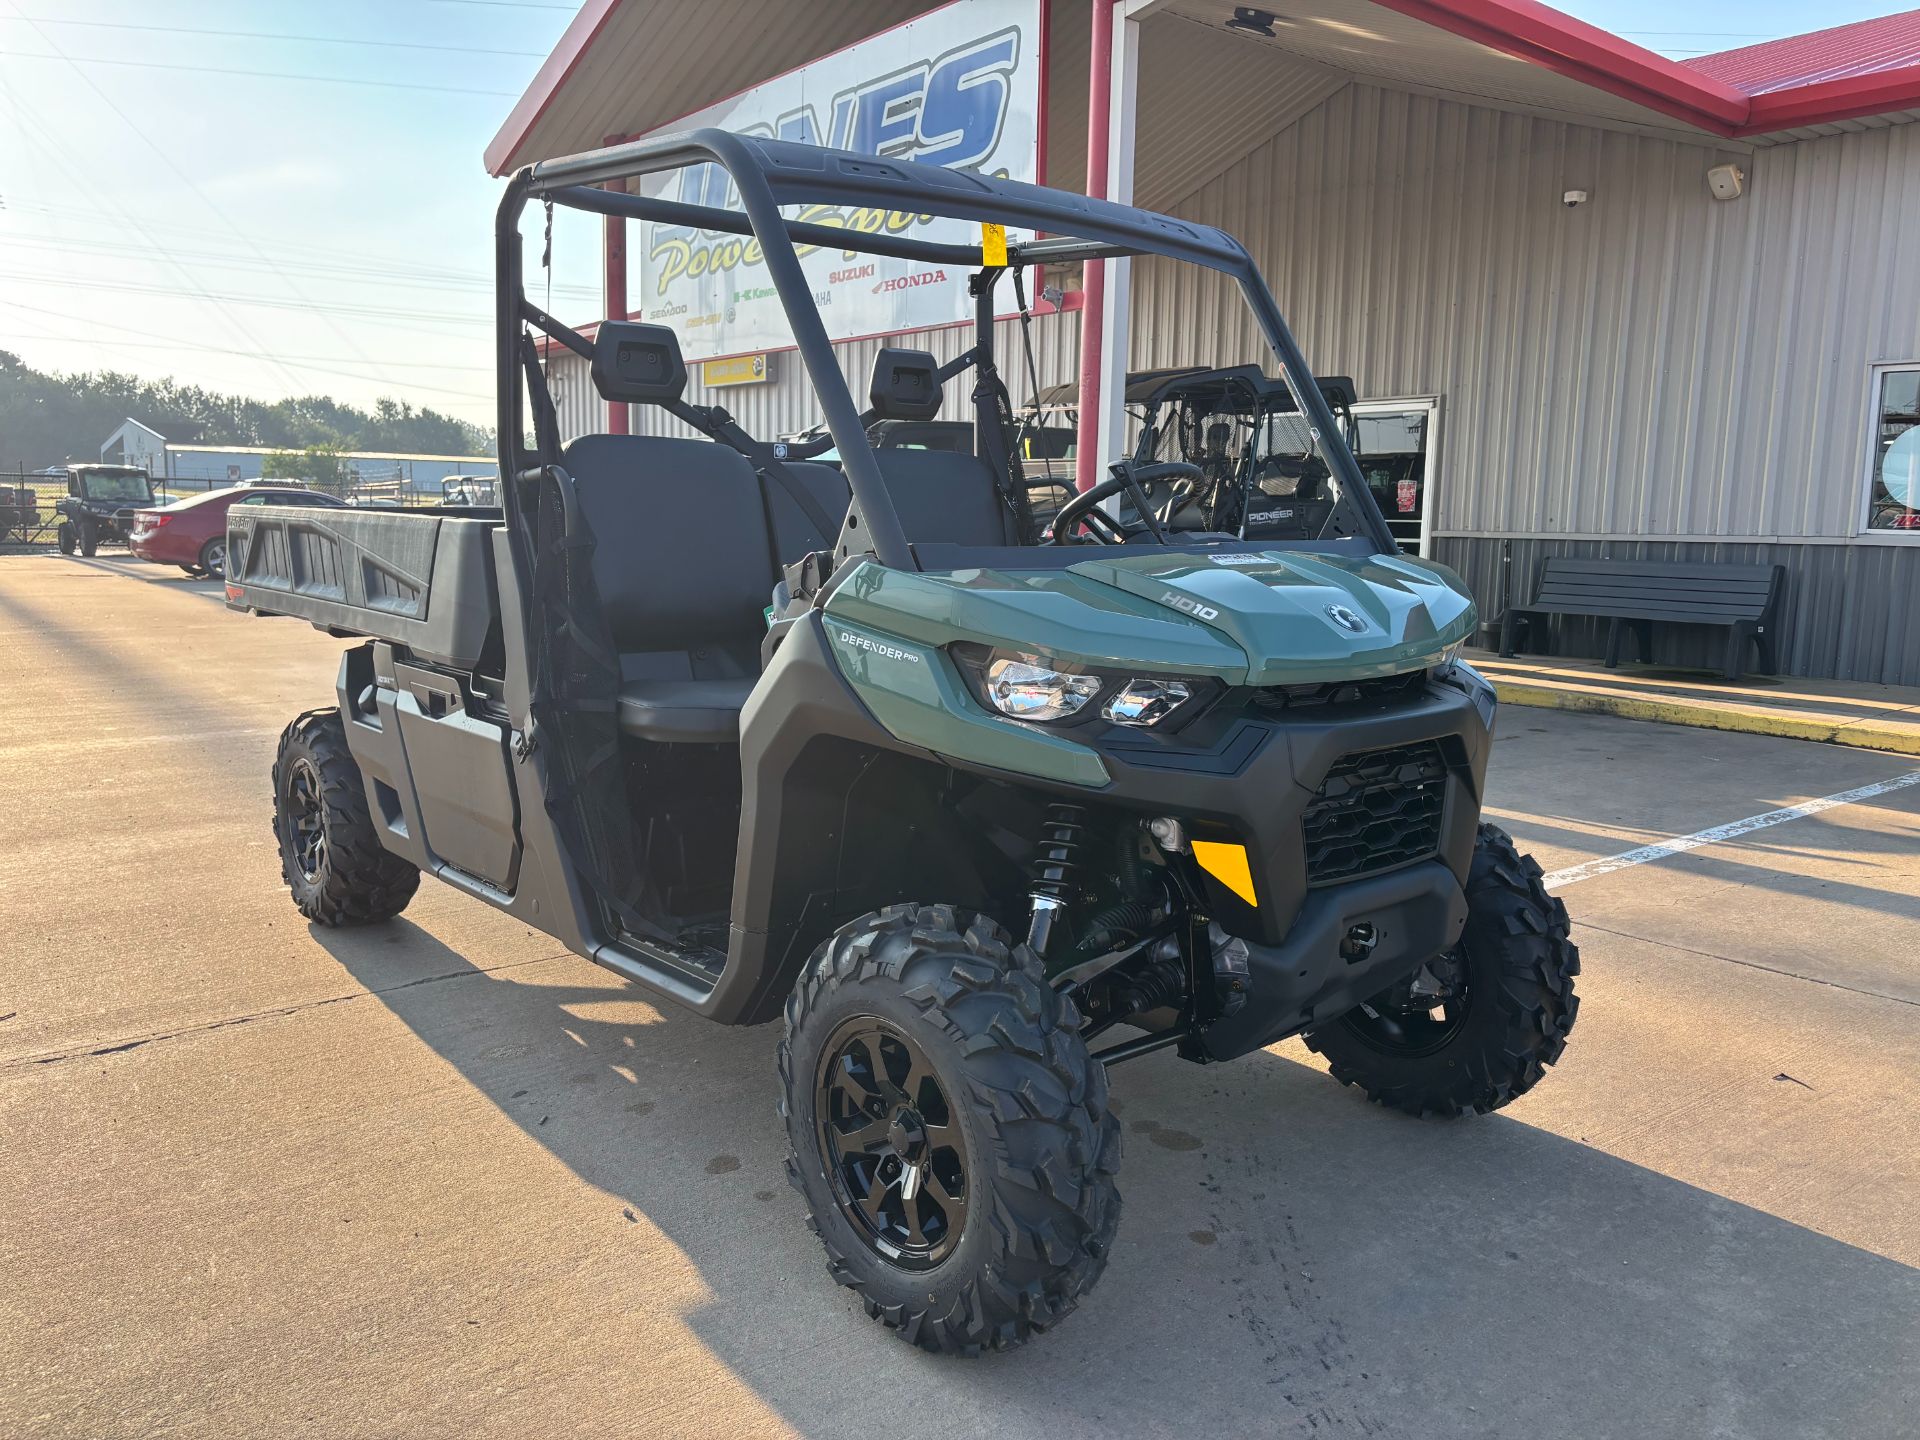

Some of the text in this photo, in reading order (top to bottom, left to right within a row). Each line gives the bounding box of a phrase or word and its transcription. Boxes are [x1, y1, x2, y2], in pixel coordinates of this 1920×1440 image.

[829, 264, 875, 284] SUZUKI
[882, 269, 947, 292] HONDA
[1248, 509, 1293, 521] PIONEER
[1161, 591, 1219, 620] HD10
[841, 632, 919, 663] DEFENDER PRO
